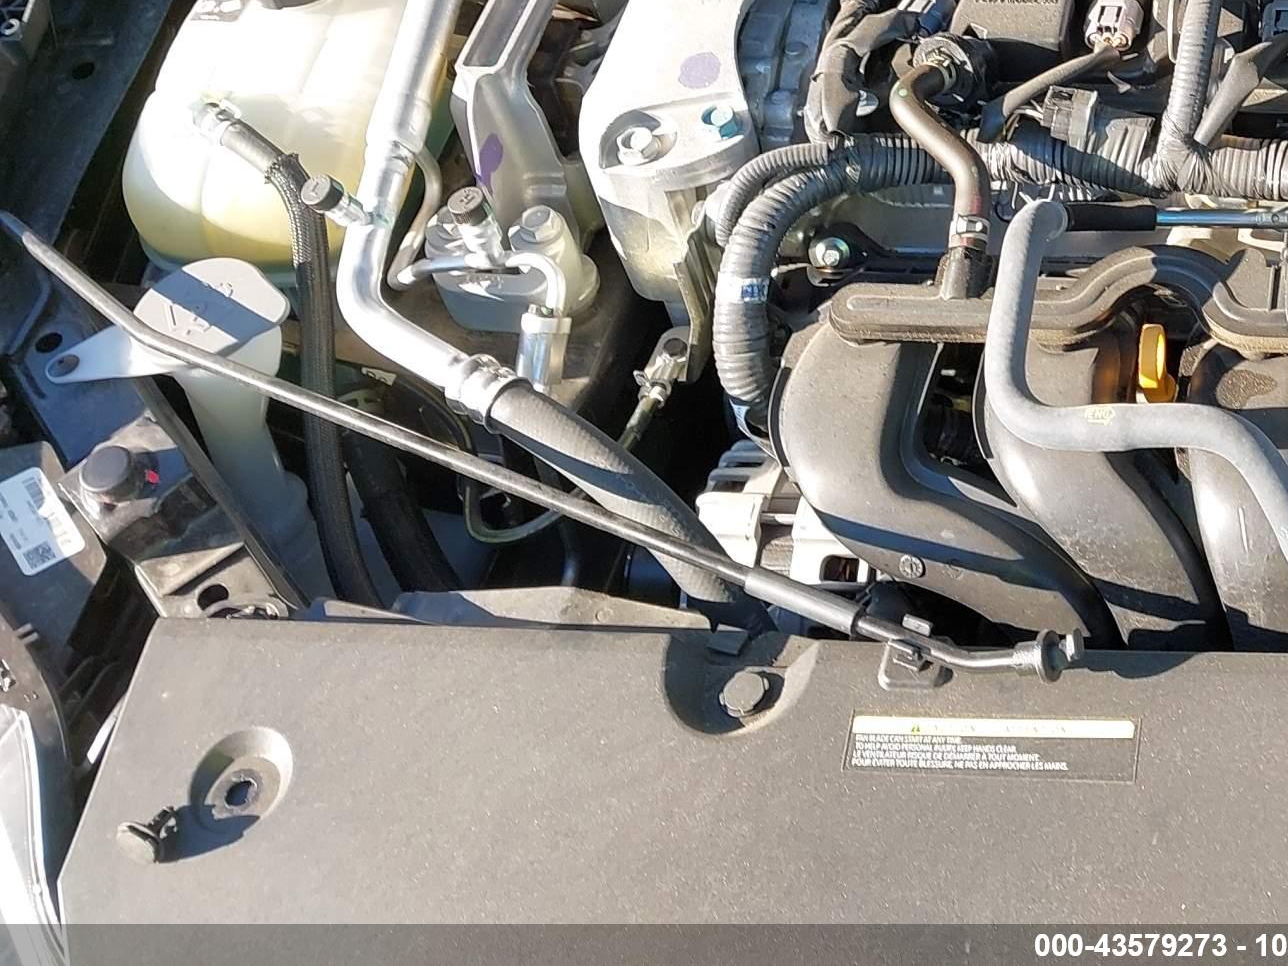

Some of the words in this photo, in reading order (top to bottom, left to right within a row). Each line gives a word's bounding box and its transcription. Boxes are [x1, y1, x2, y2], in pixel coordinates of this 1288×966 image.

[889, 734, 902, 742] CAN
[932, 735, 944, 743] ANY
[864, 741, 880, 749] HELP
[881, 742, 900, 750] AVOID
[901, 742, 932, 751] PERSONAL
[973, 744, 994, 752] HANDS
[852, 758, 871, 766] POUR
[895, 759, 918, 767] TOUTE
[964, 760, 977, 768] PAS
[1031, 761, 1042, 769] LES
